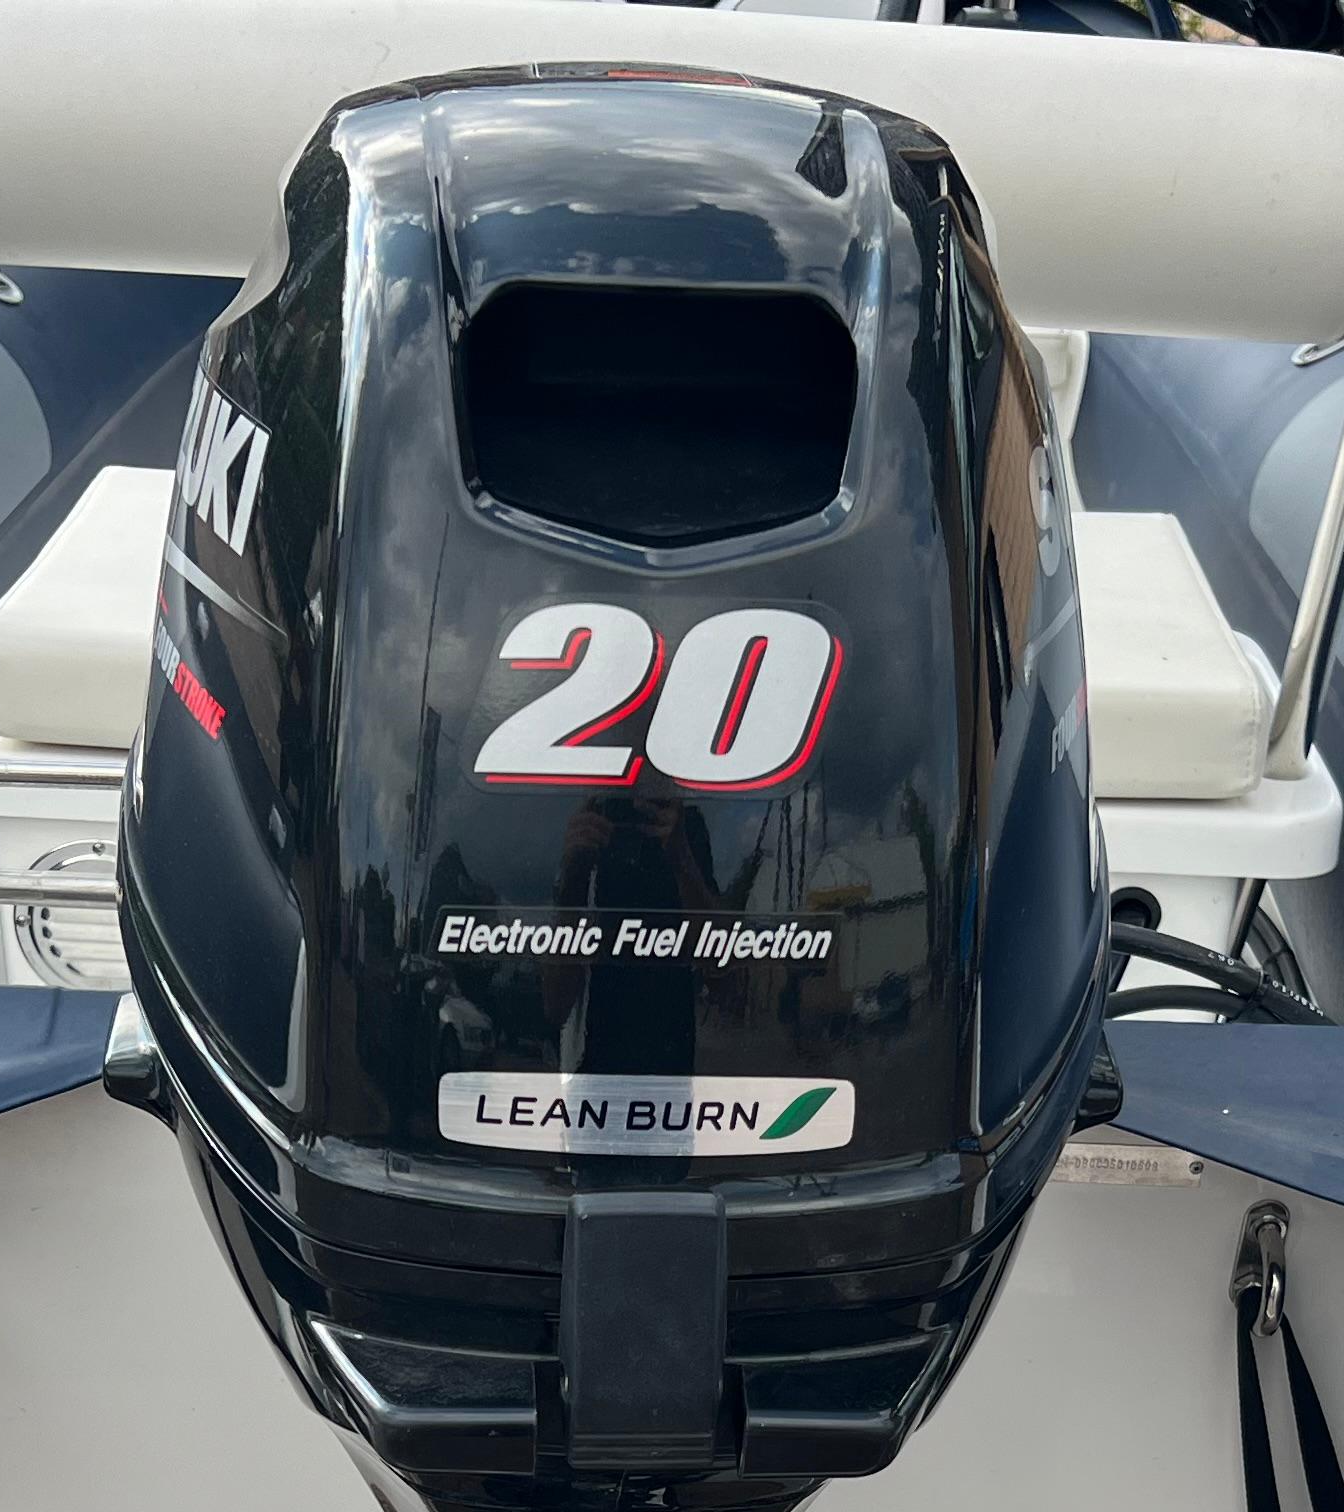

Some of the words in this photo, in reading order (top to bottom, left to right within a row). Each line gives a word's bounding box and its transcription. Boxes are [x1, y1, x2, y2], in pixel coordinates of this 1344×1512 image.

[176, 364, 270, 557] UKI
[156, 616, 227, 740] OURSTROKE
[473, 602, 844, 791] 20
[437, 914, 603, 956] Electronic
[611, 918, 690, 958] Fuel
[693, 919, 833, 967] Injection
[475, 1093, 609, 1131] LEAN
[625, 1100, 760, 1132] BURN
